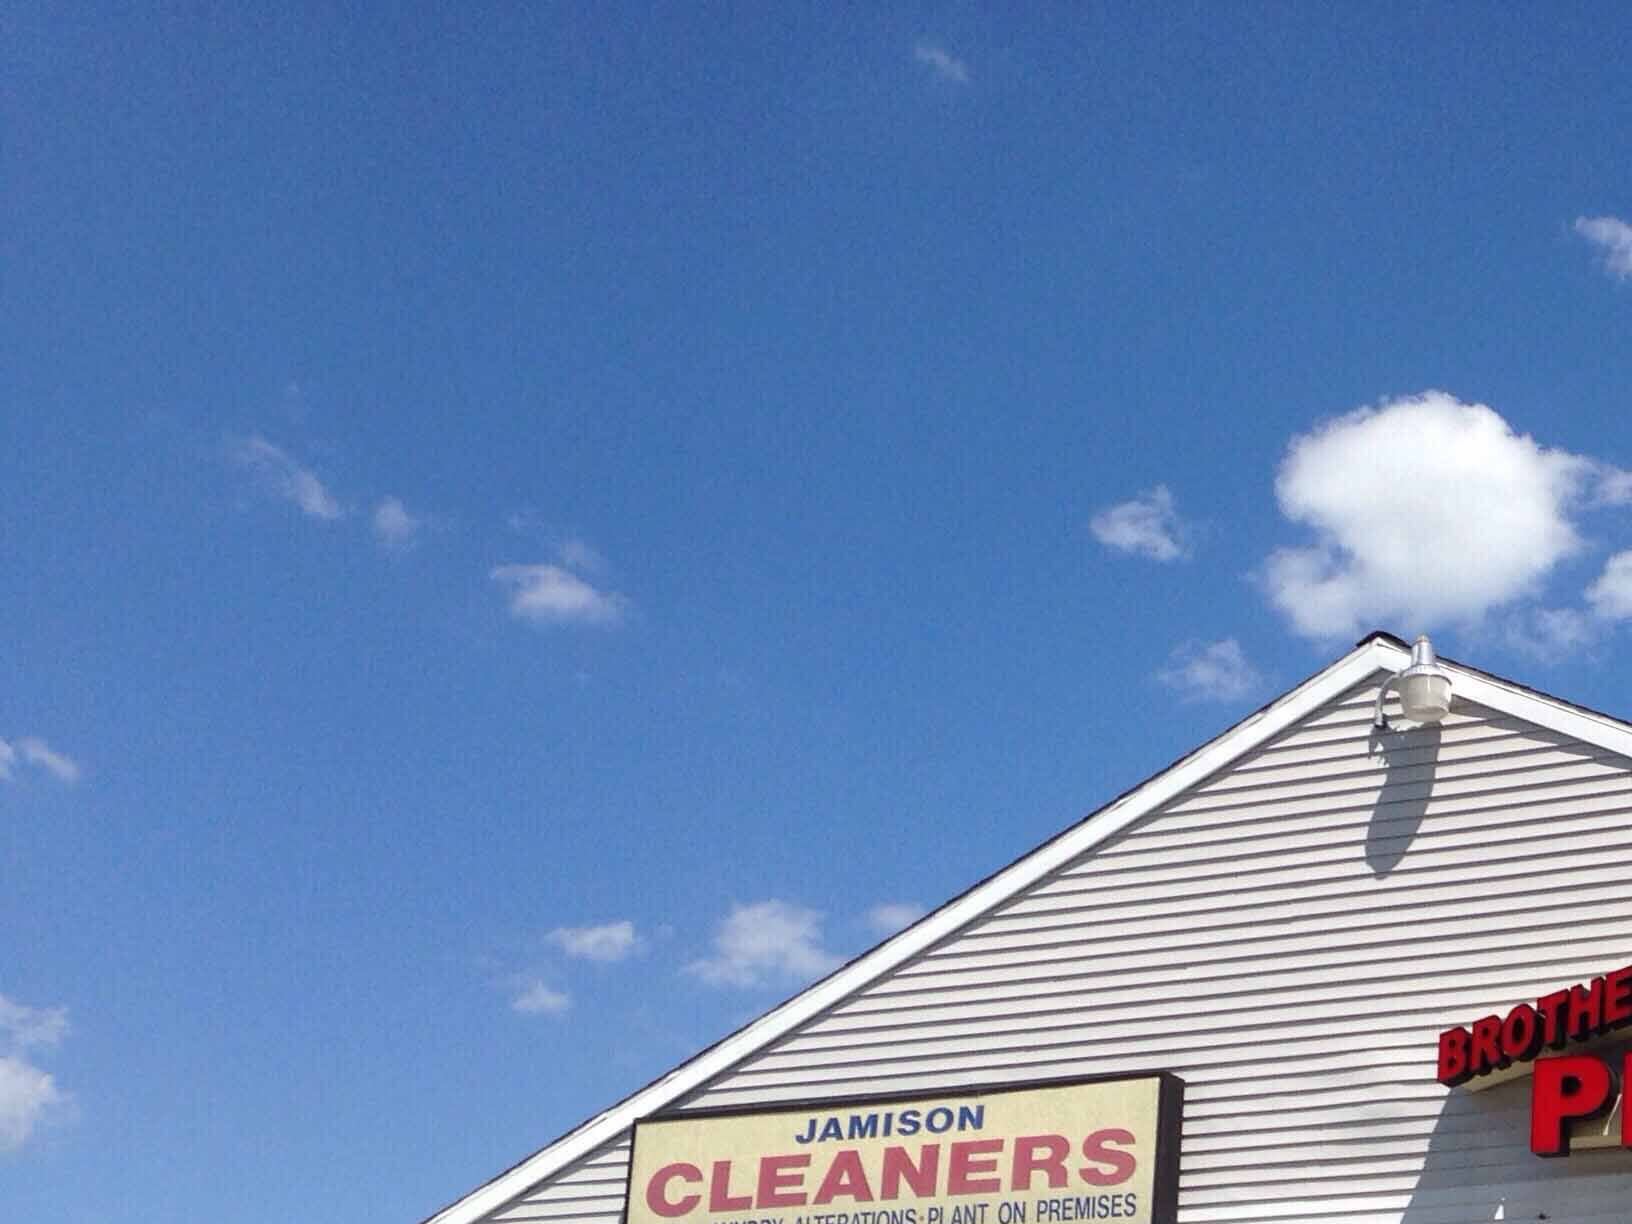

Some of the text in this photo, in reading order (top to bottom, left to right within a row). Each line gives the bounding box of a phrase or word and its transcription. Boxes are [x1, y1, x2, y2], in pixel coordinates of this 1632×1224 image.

[795, 1105, 984, 1145] JAMISON
[646, 1128, 1137, 1218] CLEANERS
[998, 1201, 1026, 1224] ON
[1036, 1193, 1137, 1222] PREMISES
